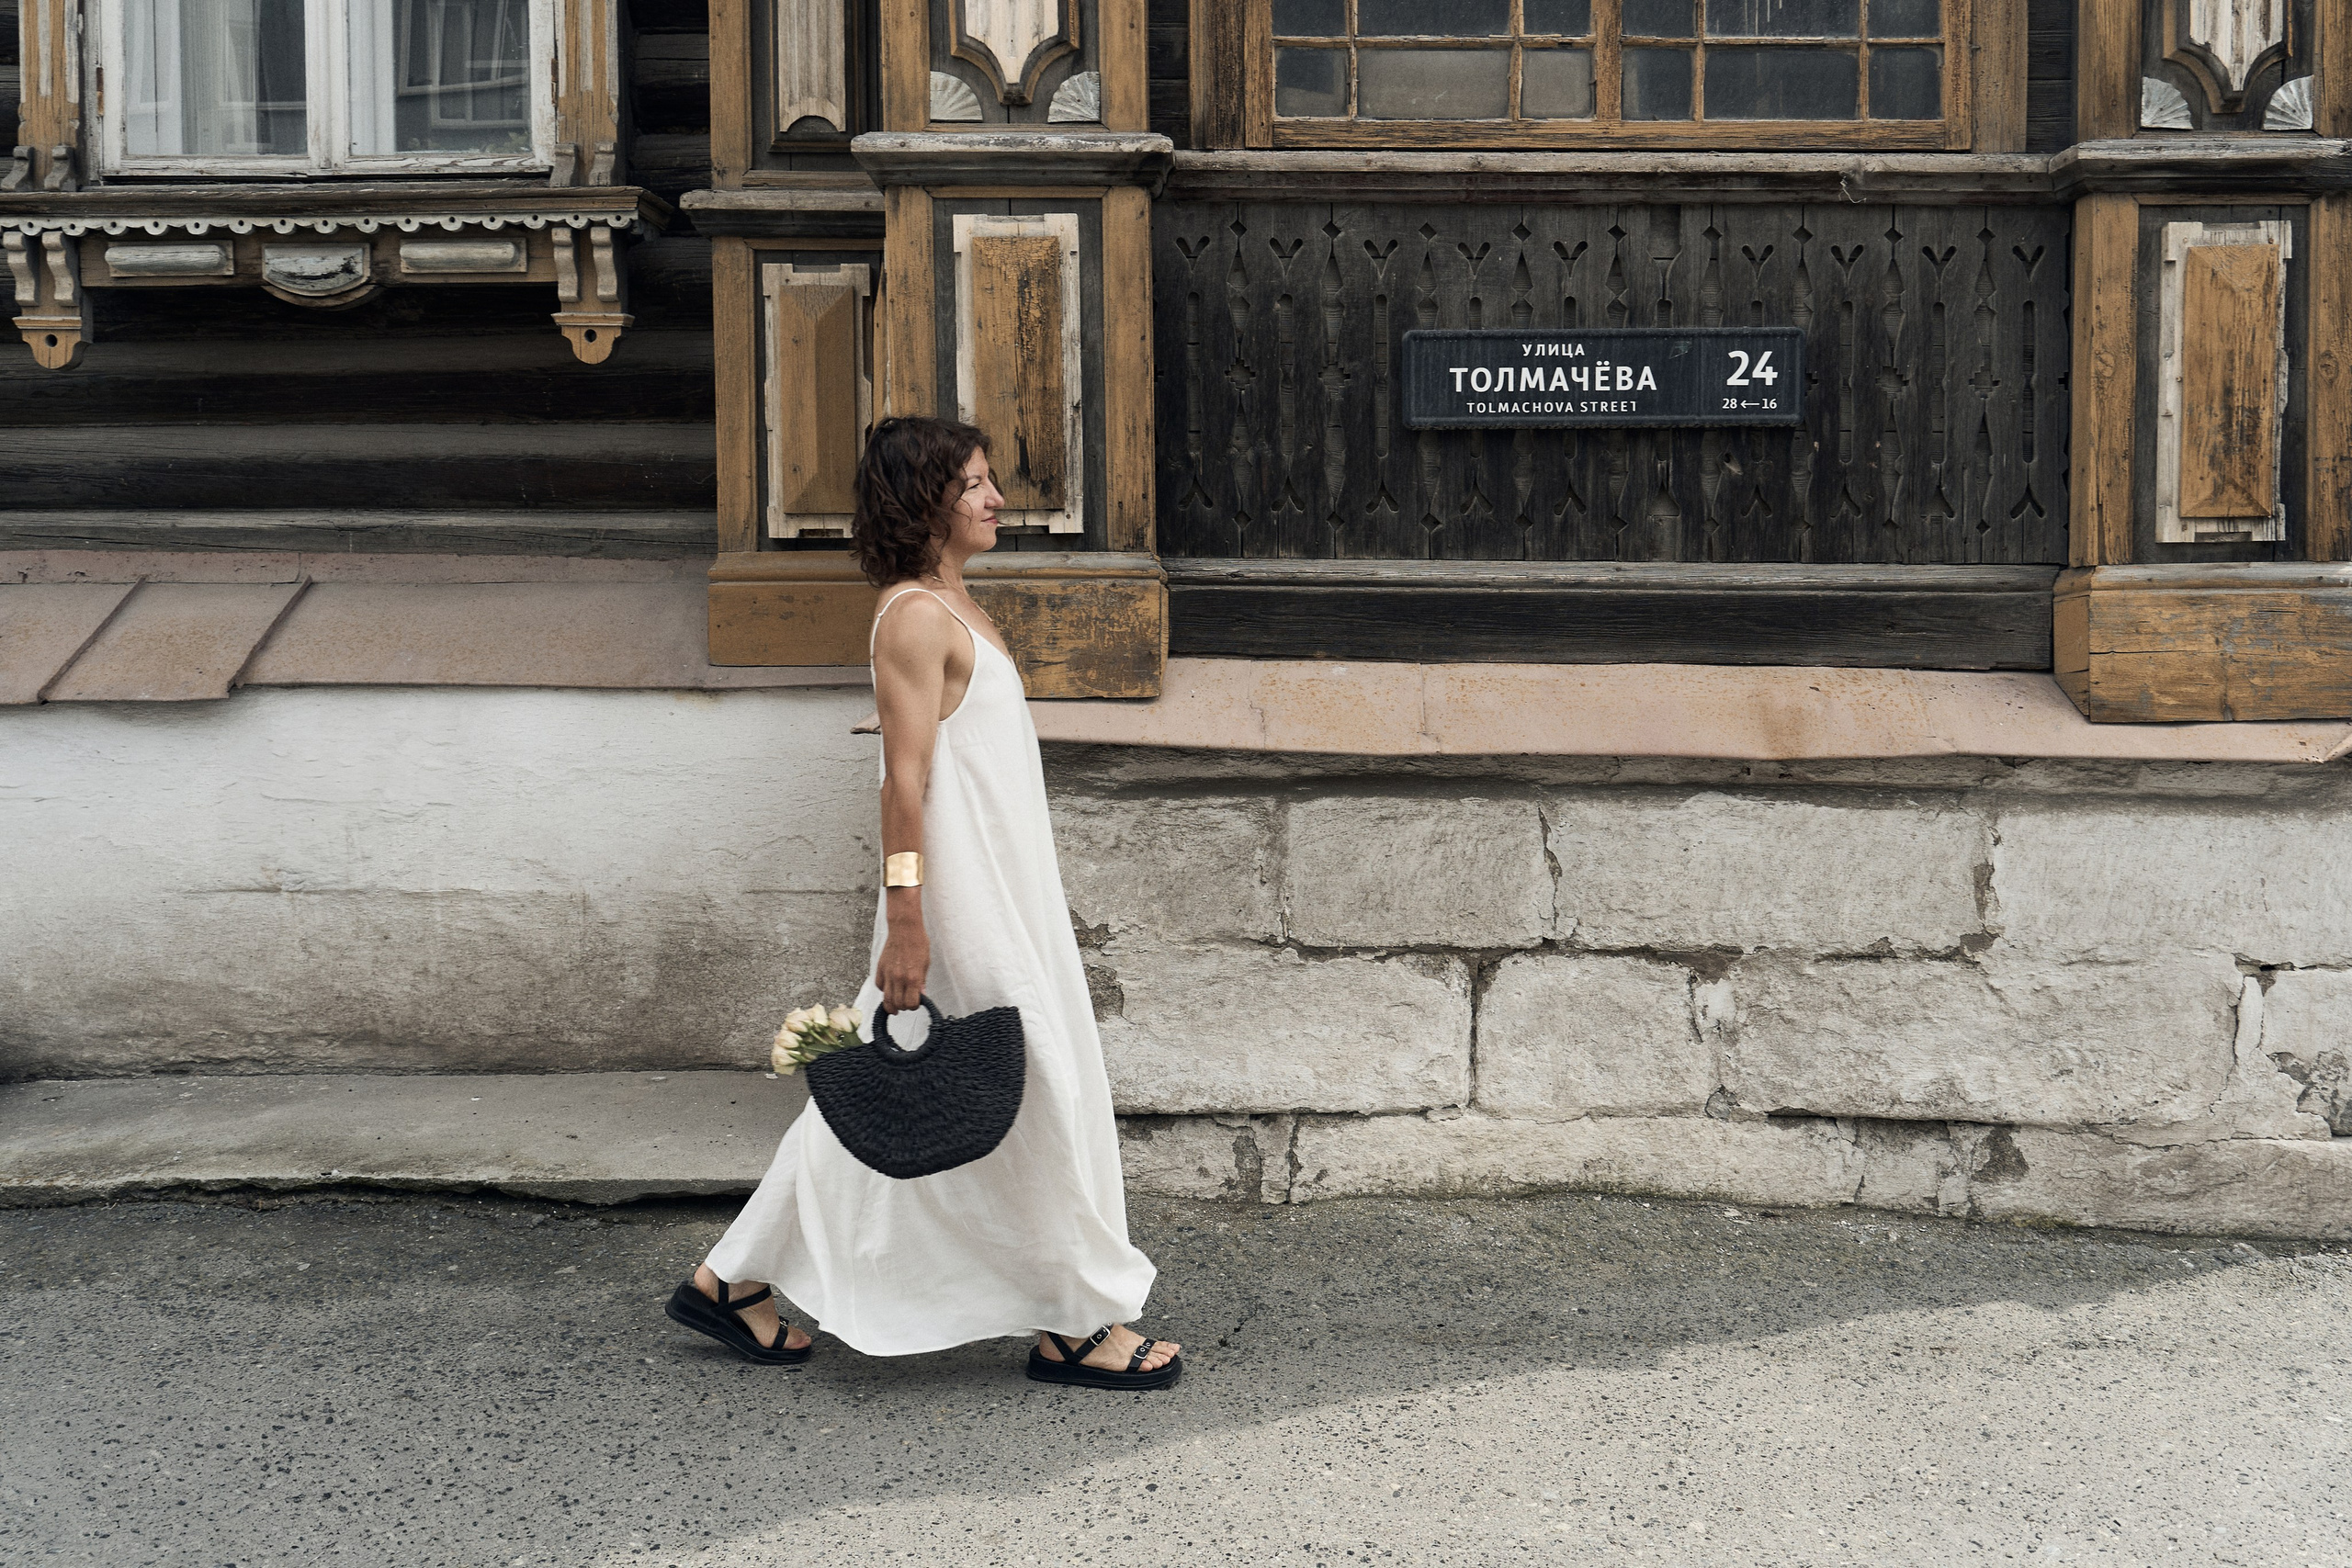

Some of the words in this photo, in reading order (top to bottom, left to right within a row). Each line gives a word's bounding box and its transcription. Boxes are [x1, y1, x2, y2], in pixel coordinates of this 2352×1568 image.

[1521, 344, 1586, 358] УЛИЦА
[1449, 360, 1657, 393] ТОЛМАЧЁВА
[1726, 350, 1779, 386] 24
[1465, 401, 1574, 413] TOLMACHOVA
